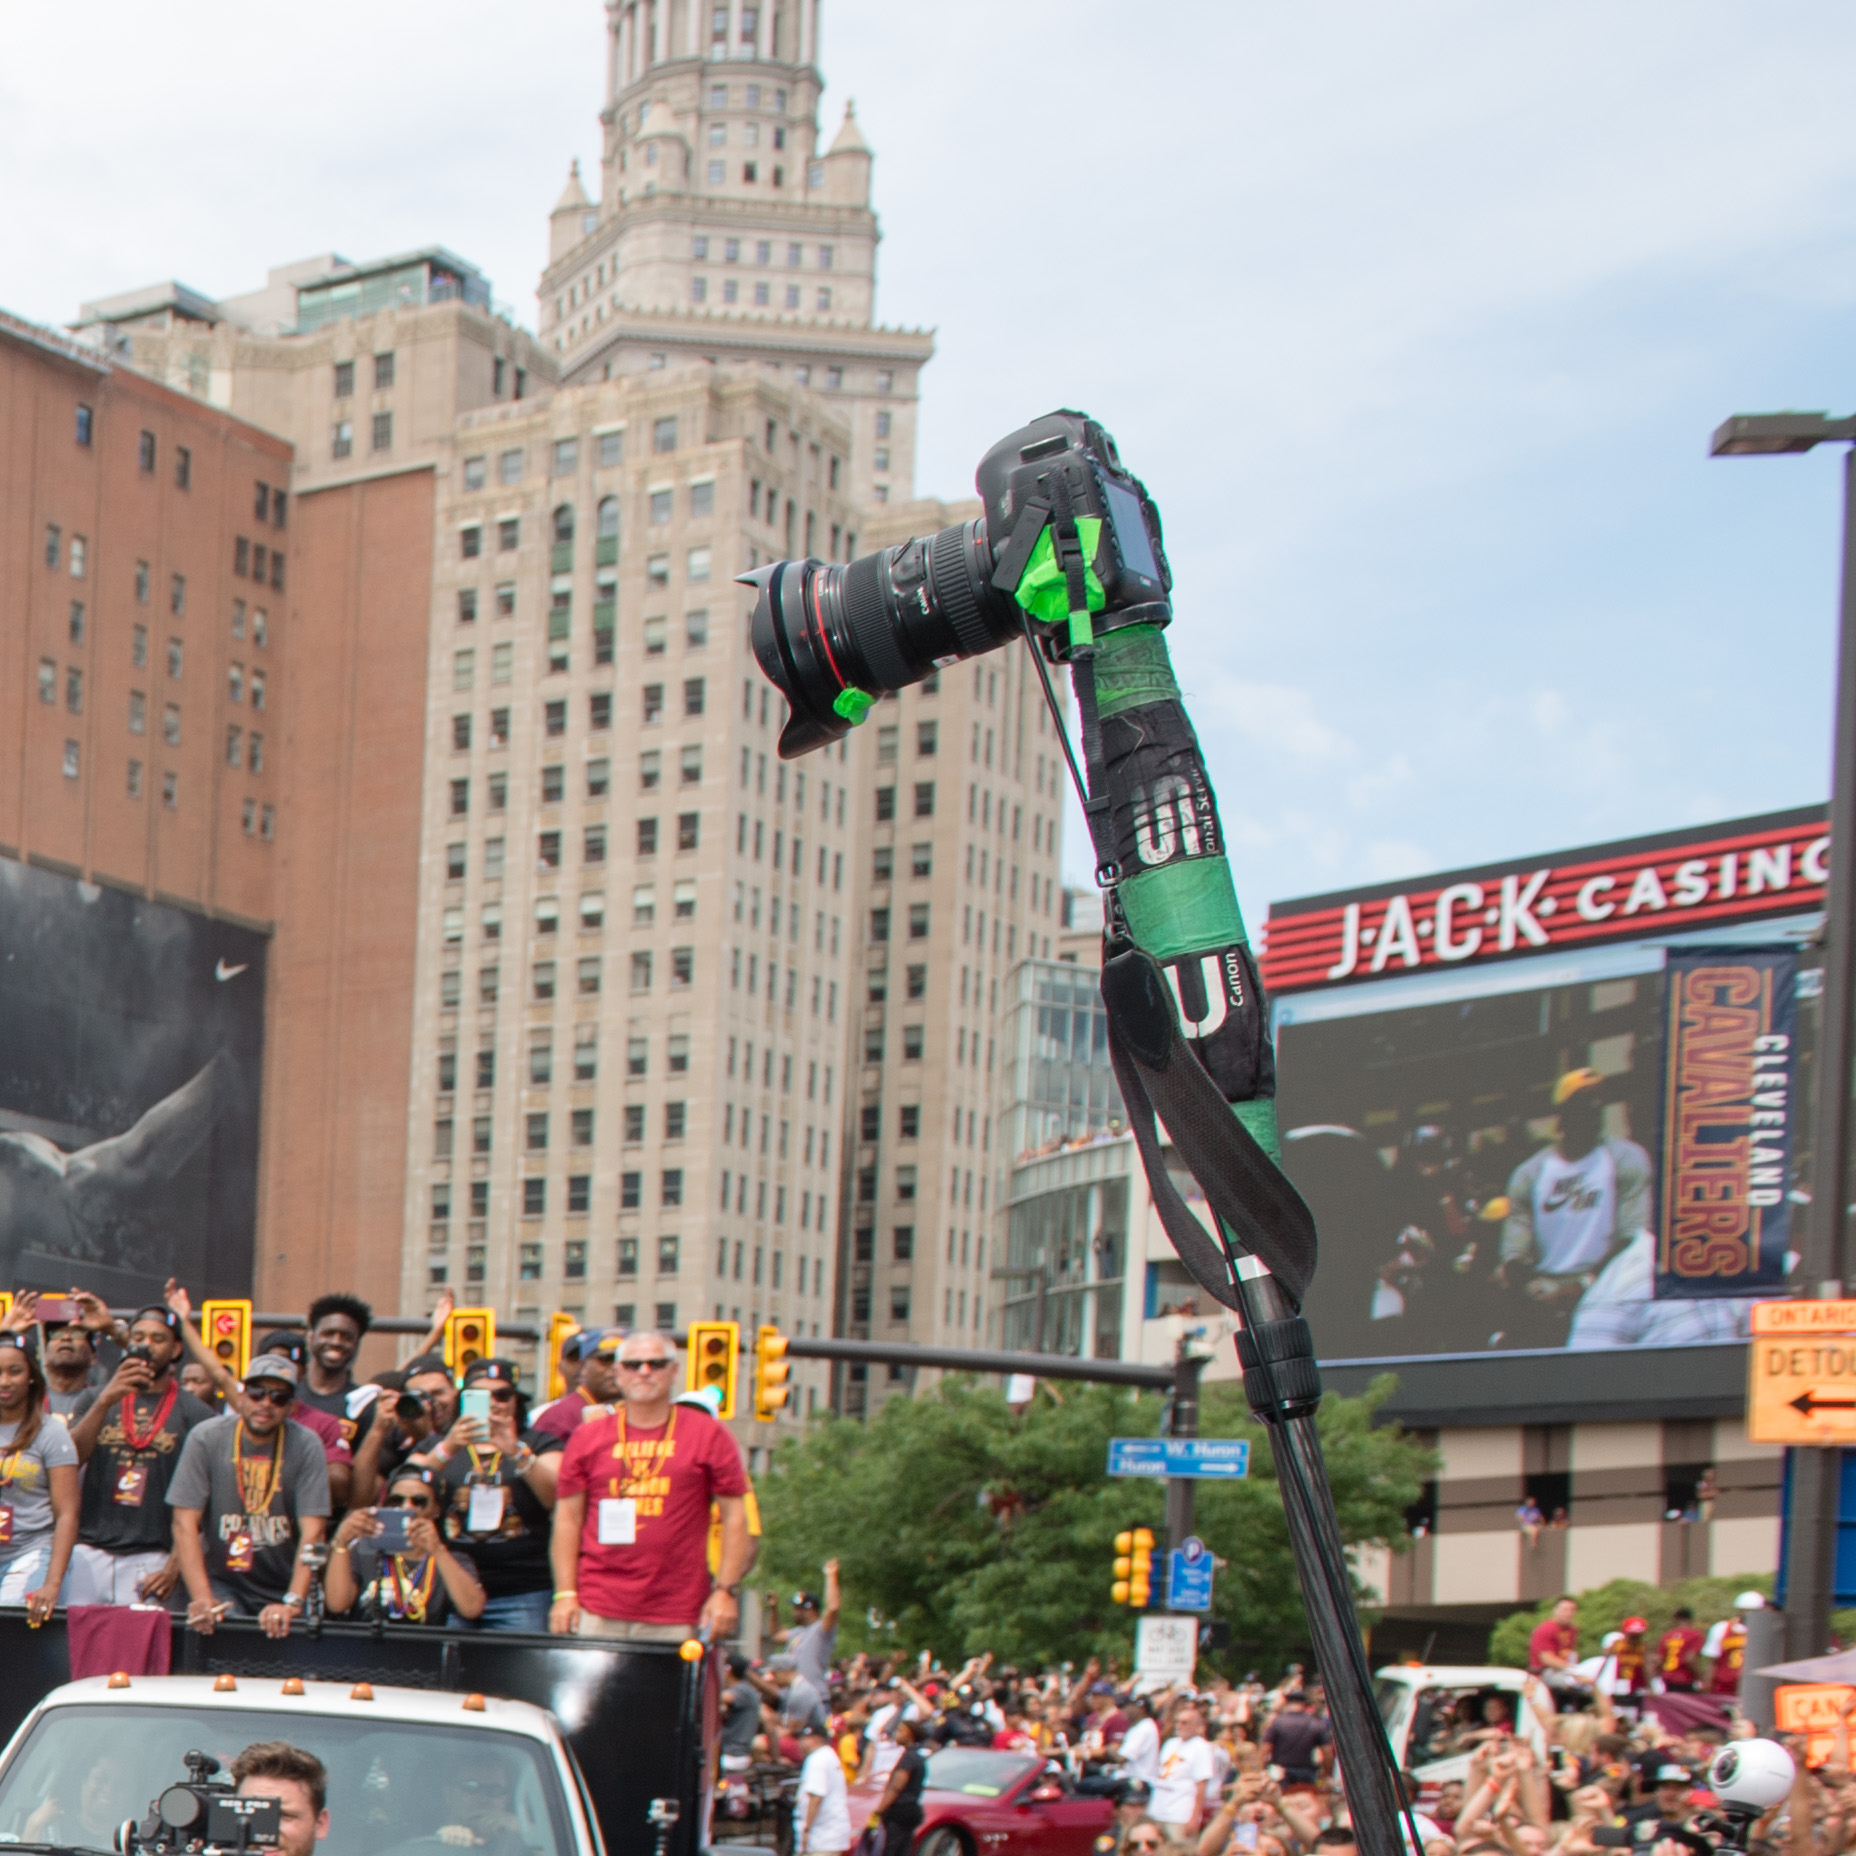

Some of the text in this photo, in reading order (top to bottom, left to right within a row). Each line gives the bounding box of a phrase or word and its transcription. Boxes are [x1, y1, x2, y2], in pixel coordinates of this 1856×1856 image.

[1224, 953, 1244, 1008] Canon
[1673, 965, 1761, 1278] CAVALIERS
[1746, 1034, 1788, 1207] CLEVELAND
[1119, 1458, 1167, 1473] Huron
[1193, 1442, 1242, 1457] Huron
